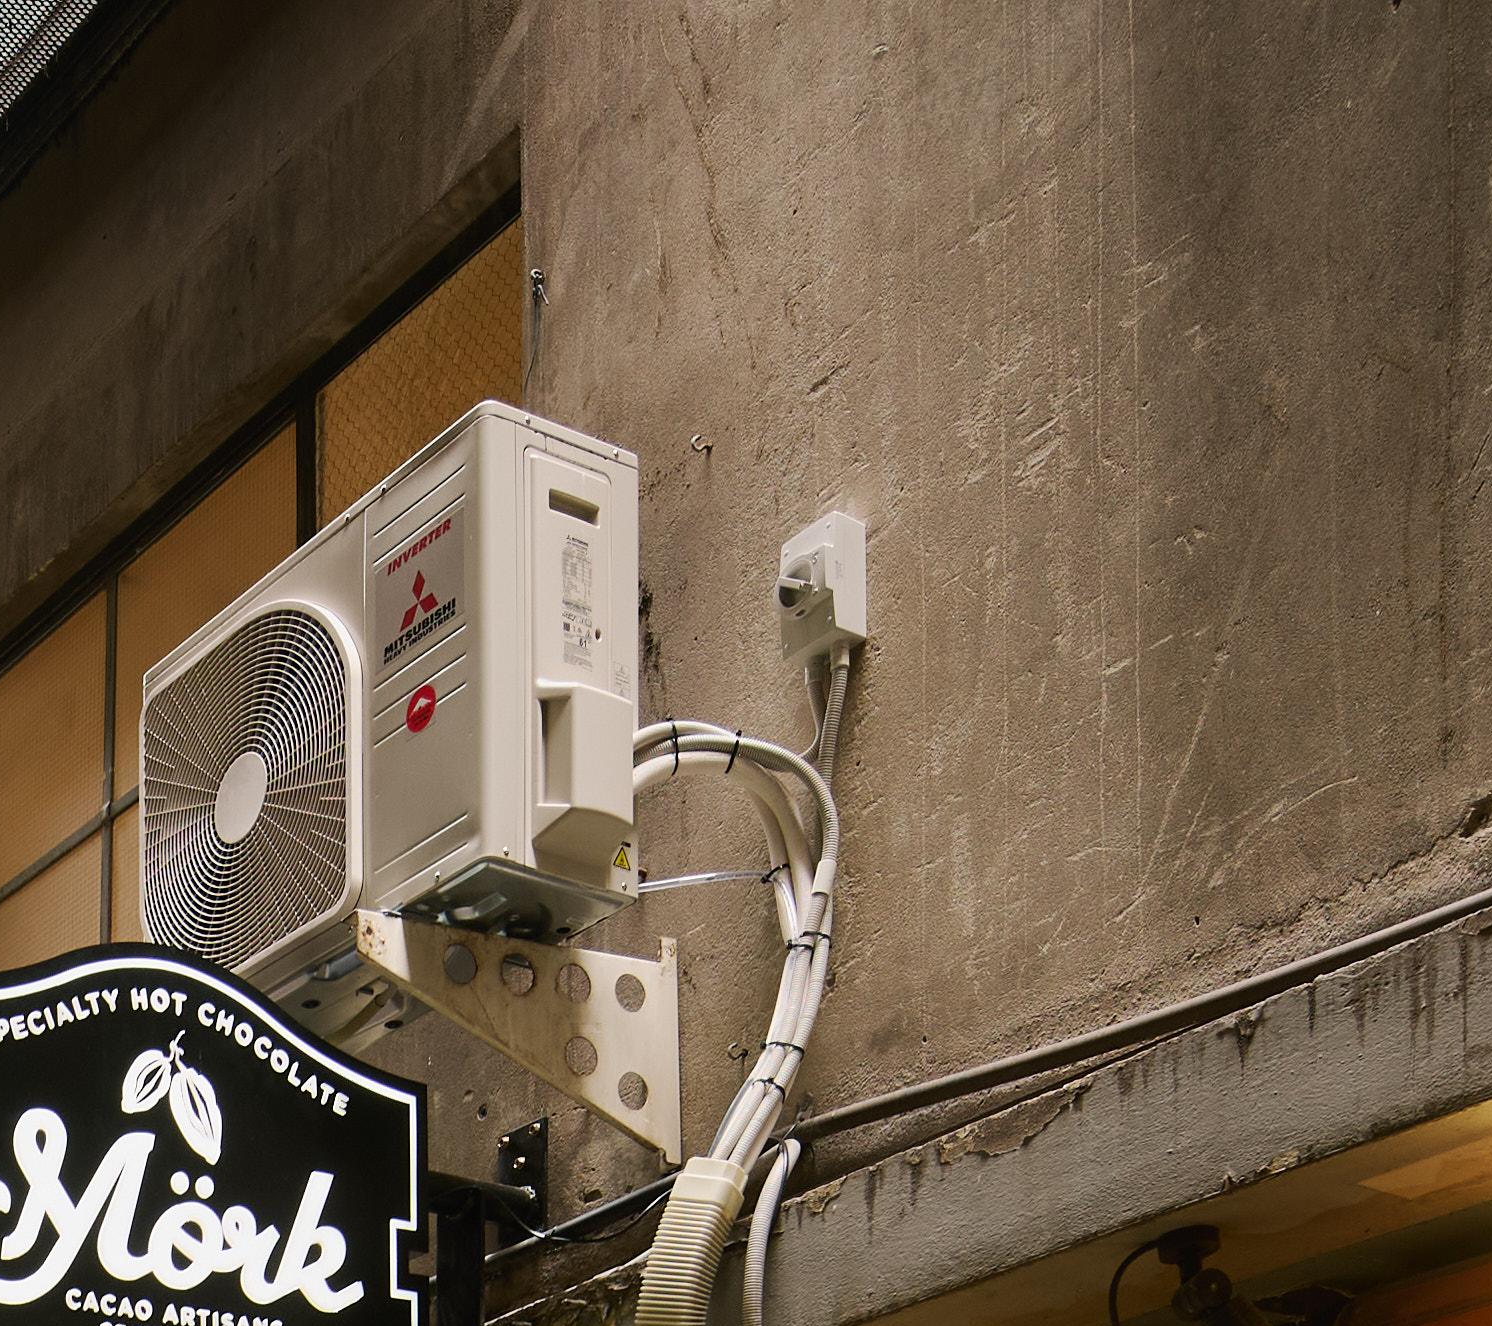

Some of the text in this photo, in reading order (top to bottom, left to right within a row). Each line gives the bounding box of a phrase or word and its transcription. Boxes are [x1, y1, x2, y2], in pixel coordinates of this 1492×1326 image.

[386, 519, 452, 576] INVERTER
[383, 597, 456, 658] MITSUBISHI
[129, 987, 188, 1017] HOT
[196, 1001, 350, 1118] CHOCOLATE
[65, 1287, 152, 1322] CACAO
